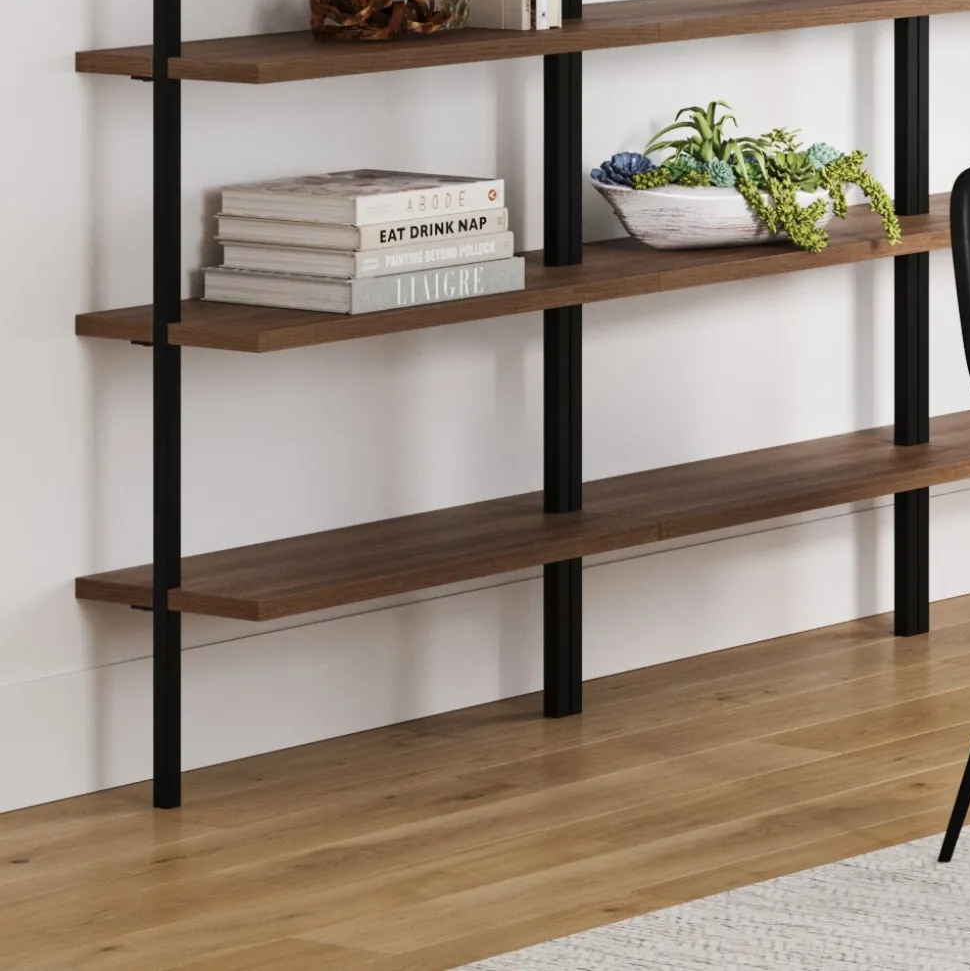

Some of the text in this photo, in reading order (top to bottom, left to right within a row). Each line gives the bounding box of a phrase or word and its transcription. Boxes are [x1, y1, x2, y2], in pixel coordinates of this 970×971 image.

[406, 190, 466, 213] ABODE
[379, 227, 405, 243] EAT
[409, 220, 454, 239] DRINK
[457, 216, 487, 232] NAP
[385, 251, 423, 268] PAINTING
[425, 246, 458, 263] BEYOND
[460, 240, 496, 257] POLLOCK
[397, 266, 484, 305] LIAIGRE
